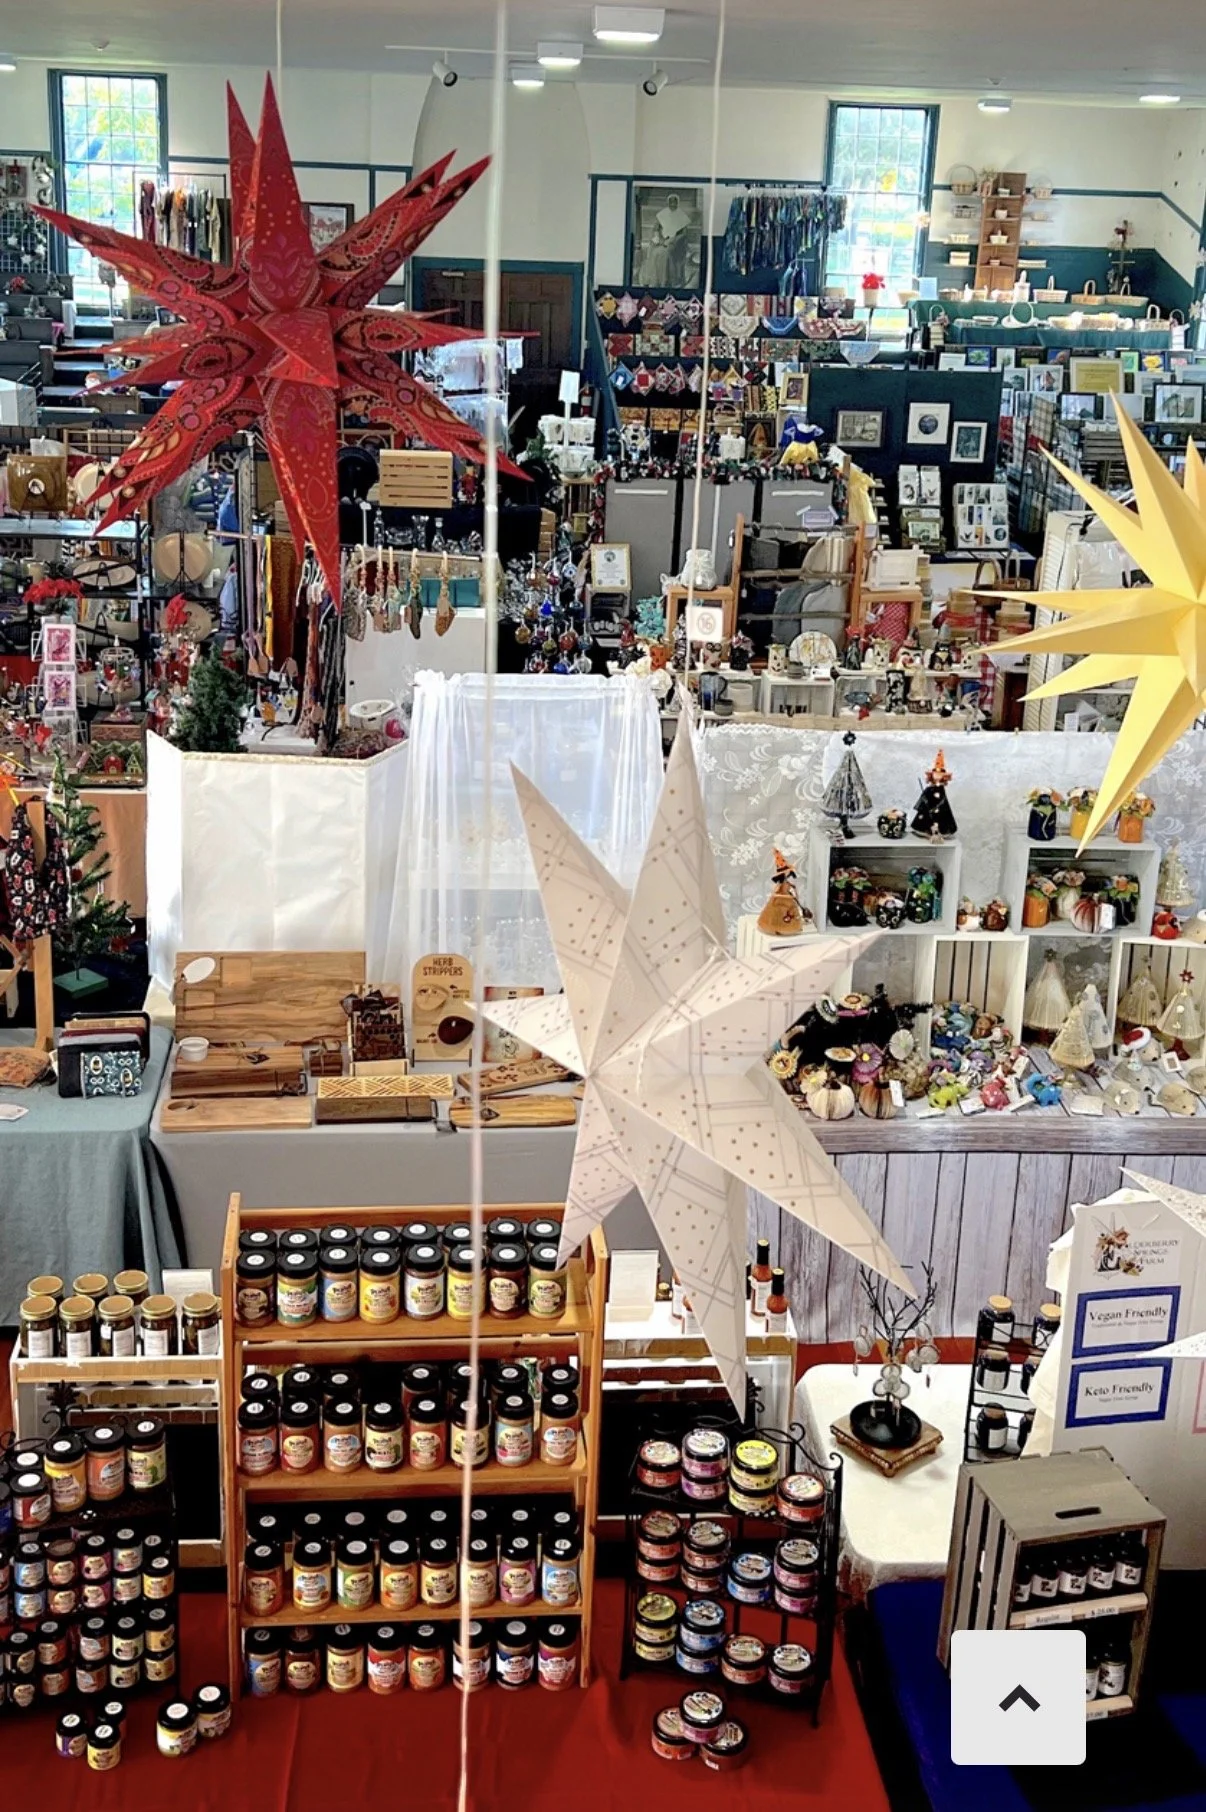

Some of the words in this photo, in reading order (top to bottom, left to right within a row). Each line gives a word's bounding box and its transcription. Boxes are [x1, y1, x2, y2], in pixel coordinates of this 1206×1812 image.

[432, 957, 453, 966] HERB
[423, 966, 463, 976] STRIPPERS
[1089, 1311, 1122, 1322] Vegan
[1124, 1305, 1168, 1318] Friendly
[1085, 1386, 1109, 1396] Keto
[1112, 1382, 1154, 1394] Friendly
